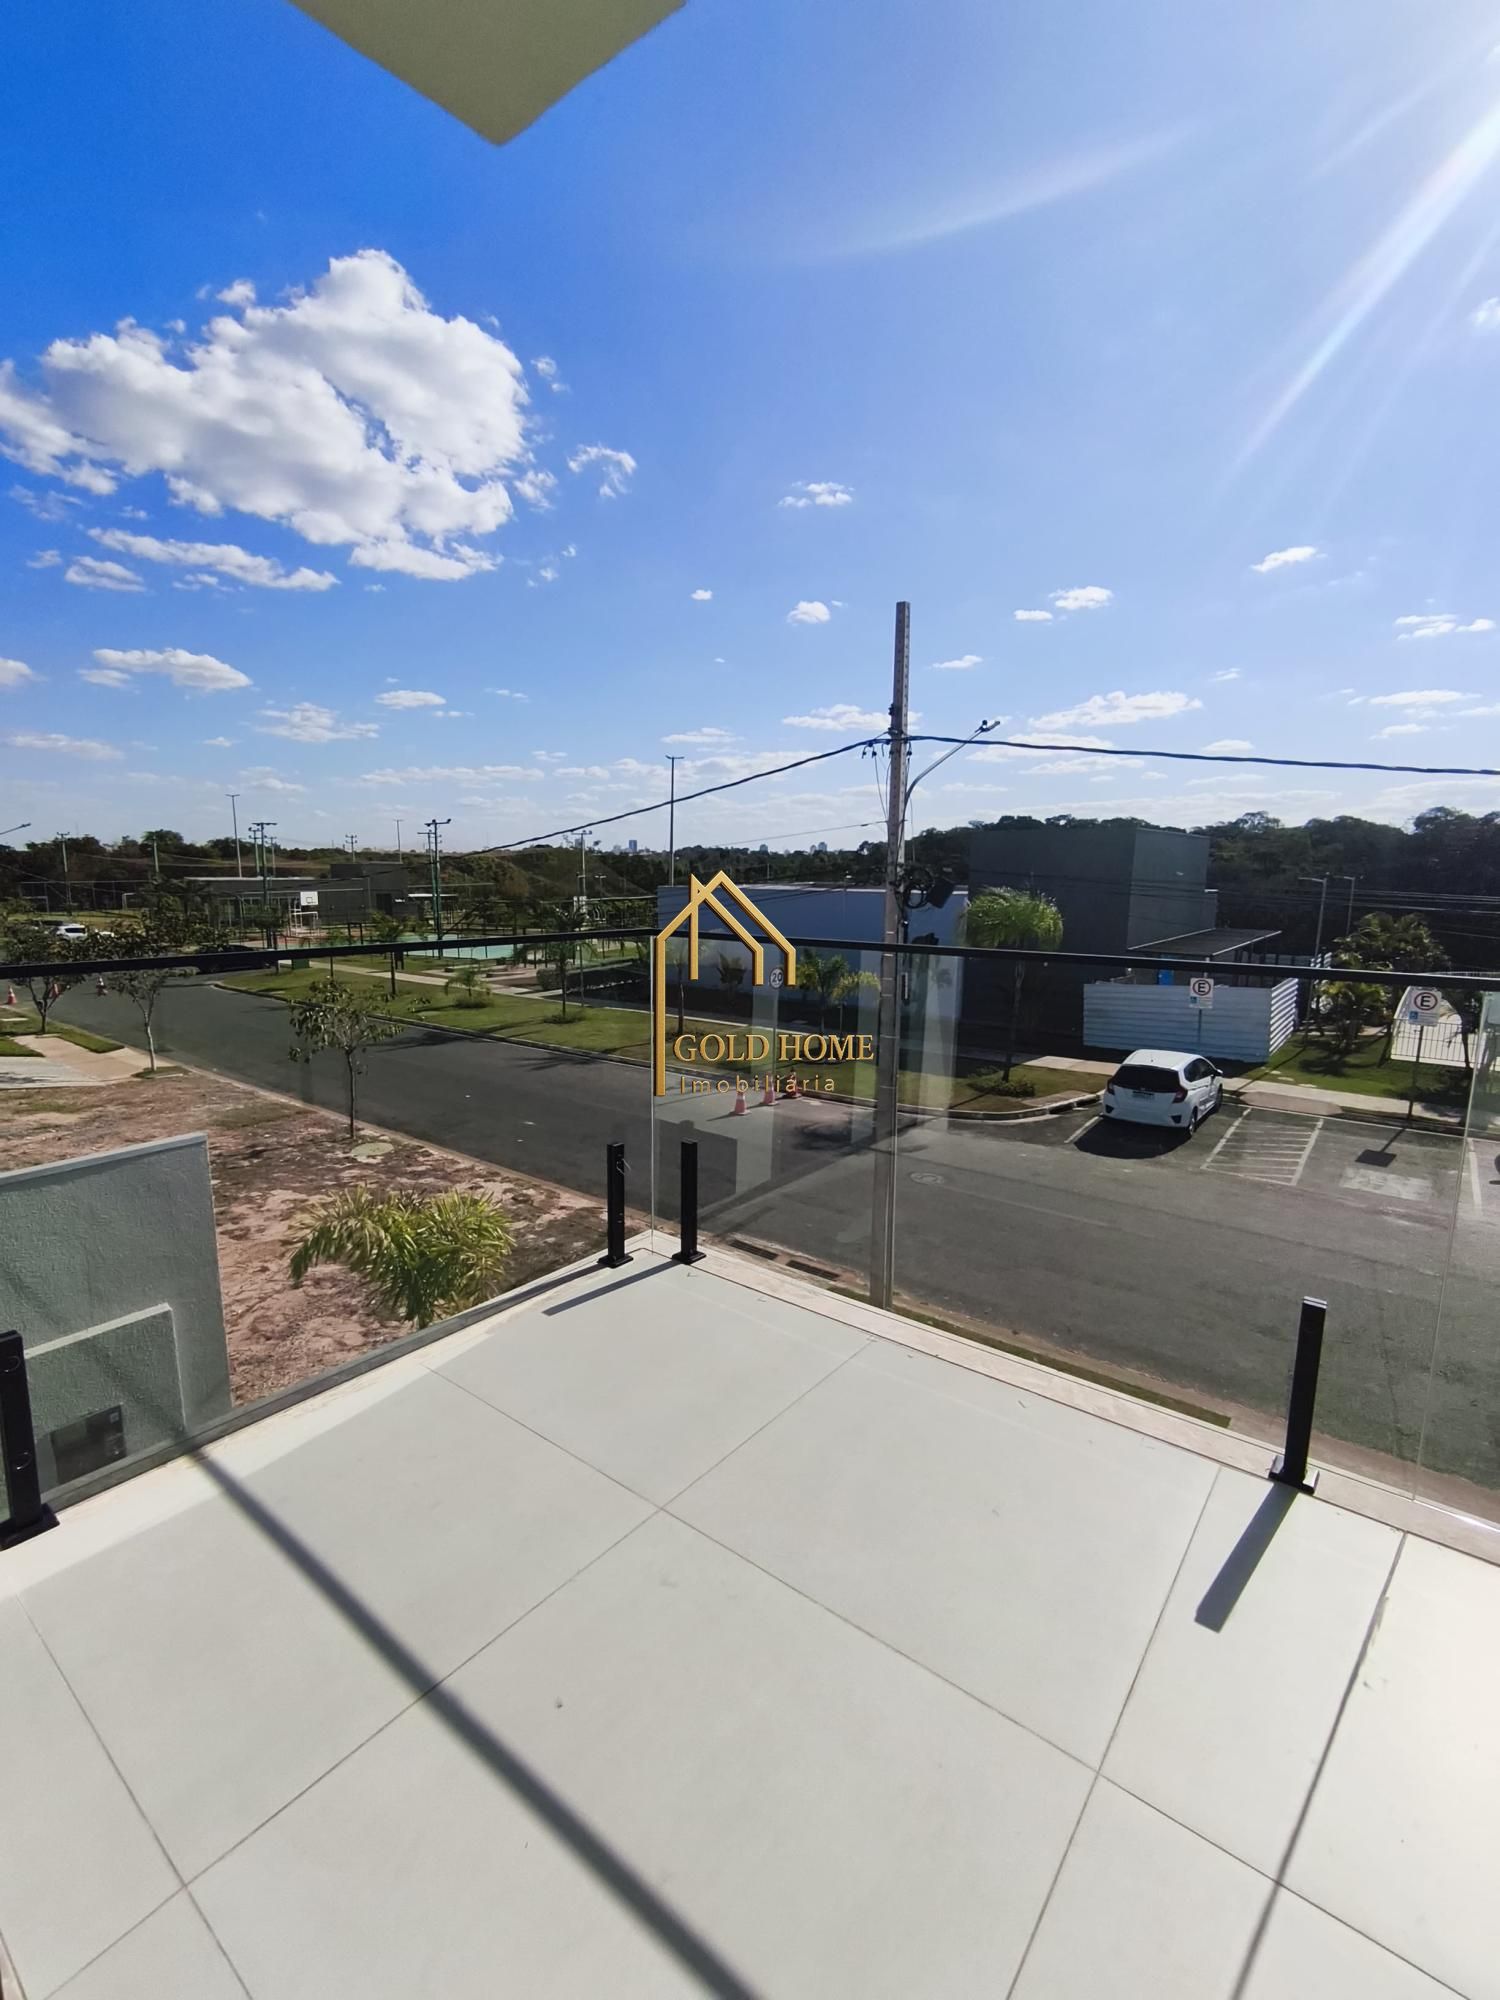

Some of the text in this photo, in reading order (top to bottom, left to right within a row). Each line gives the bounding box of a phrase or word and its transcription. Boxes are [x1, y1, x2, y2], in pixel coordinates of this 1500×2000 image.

[771, 972, 783, 982] 20
[1198, 982, 1206, 993] E
[1420, 995, 1431, 1007] E
